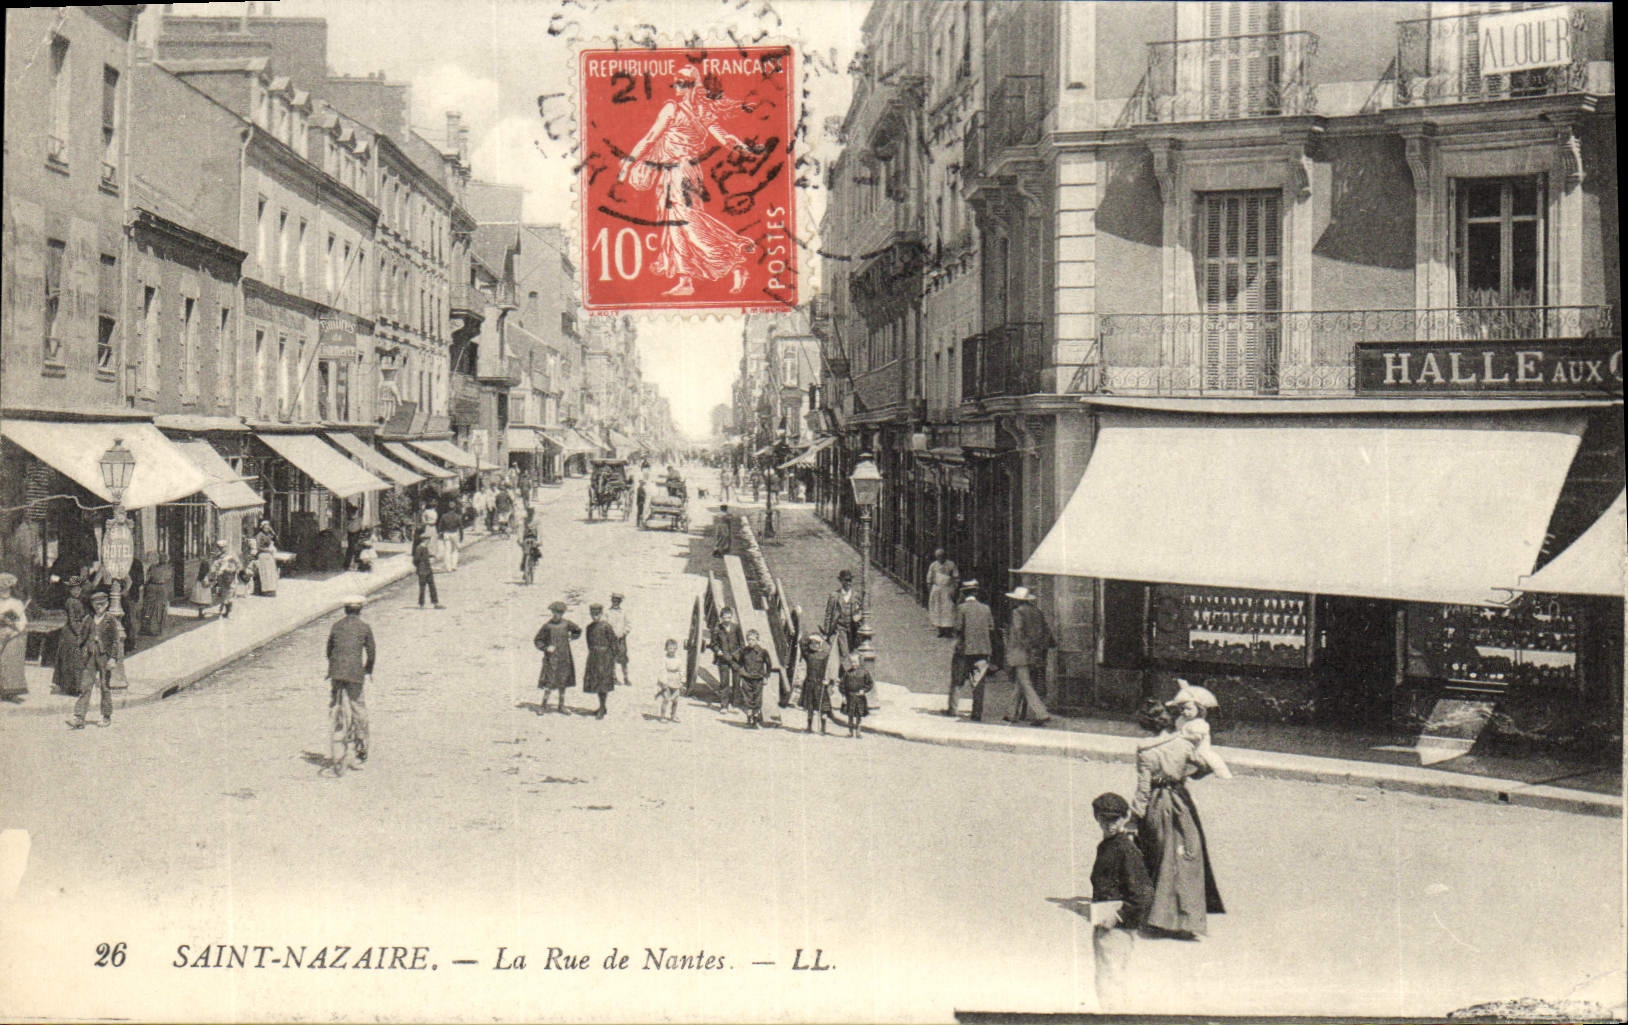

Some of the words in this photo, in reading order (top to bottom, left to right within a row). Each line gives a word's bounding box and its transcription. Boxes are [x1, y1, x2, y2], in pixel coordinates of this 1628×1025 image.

[1481, 27, 1497, 71] A
[1500, 17, 1570, 68] LOUER
[589, 59, 675, 77] REPUBLIQUE
[767, 206, 786, 290] POSTES
[1383, 350, 1544, 385] HALLE
[1551, 360, 1603, 384] AUX
